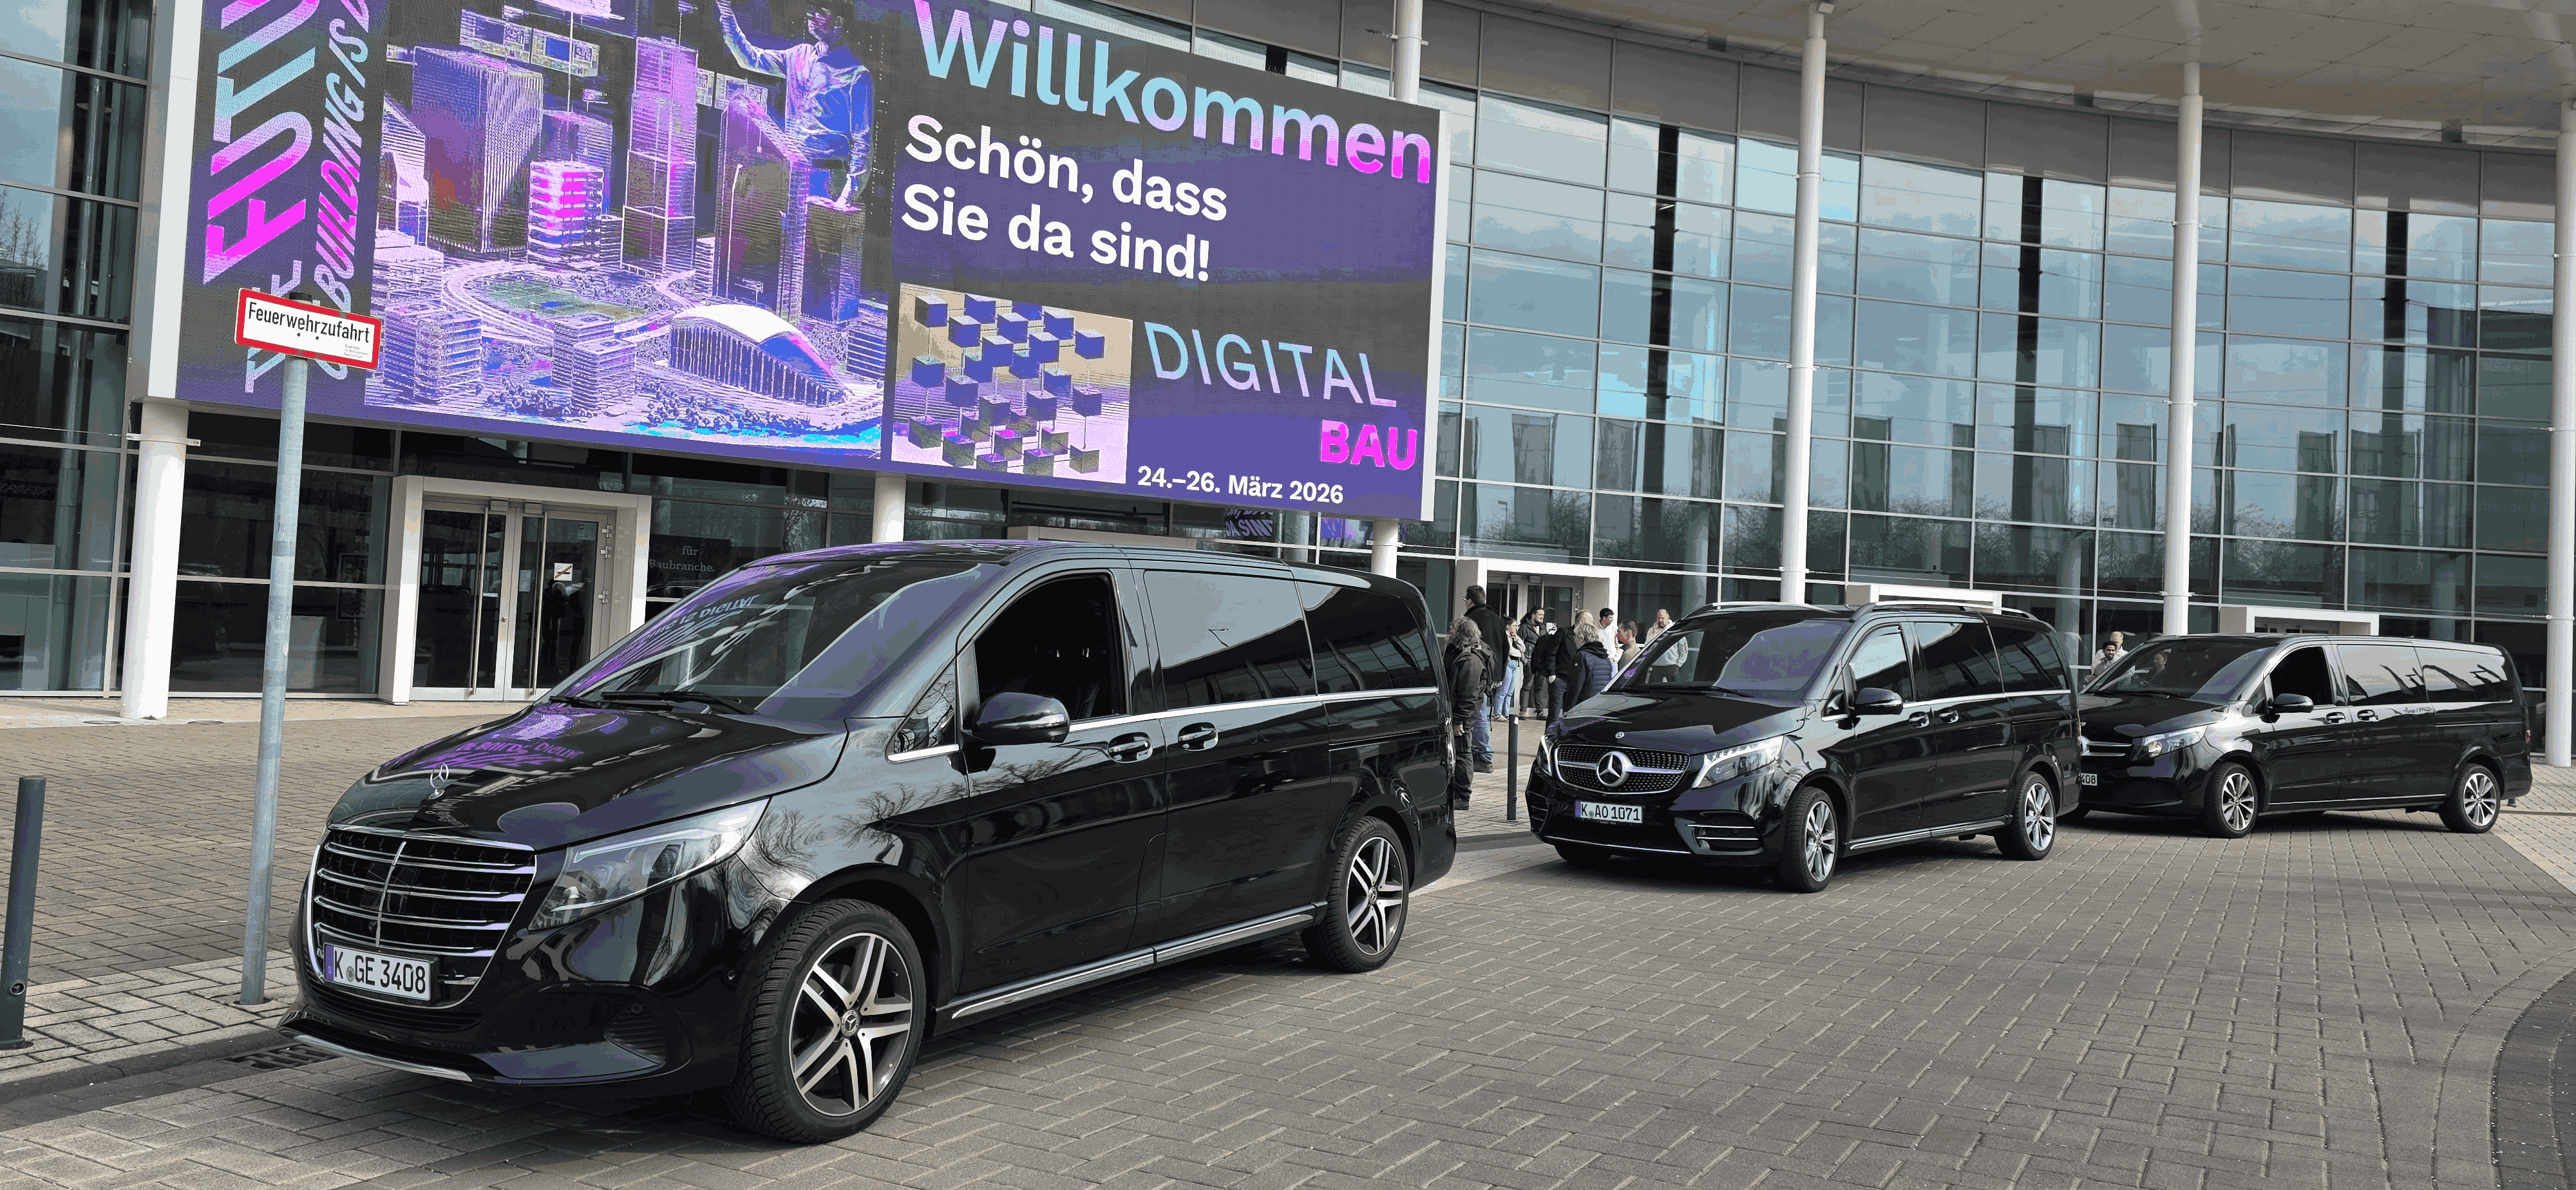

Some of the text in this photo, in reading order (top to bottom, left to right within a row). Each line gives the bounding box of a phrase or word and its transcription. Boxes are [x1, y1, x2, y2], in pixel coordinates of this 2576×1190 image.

[328, 18, 369, 89] IS
[913, 0, 1430, 184] Willkommen
[314, 72, 366, 314] BUILDING
[905, 115, 1227, 222] Schön, dass
[901, 184, 1211, 282] Sie da sind!
[249, 301, 370, 343] Feuerwehrzufahrt
[1144, 321, 1397, 408] DIGITAL
[1320, 420, 1417, 471] BAU
[1228, 473, 1283, 500] März
[1289, 479, 1344, 505] 2026
[649, 558, 715, 572] Baubranche.
[681, 545, 699, 556] für
[1581, 803, 1587, 817] K
[1595, 805, 1609, 818] AO
[1611, 806, 1640, 821] 1071
[334, 950, 344, 979] K
[355, 955, 375, 986] GE
[380, 959, 426, 994] 3408
